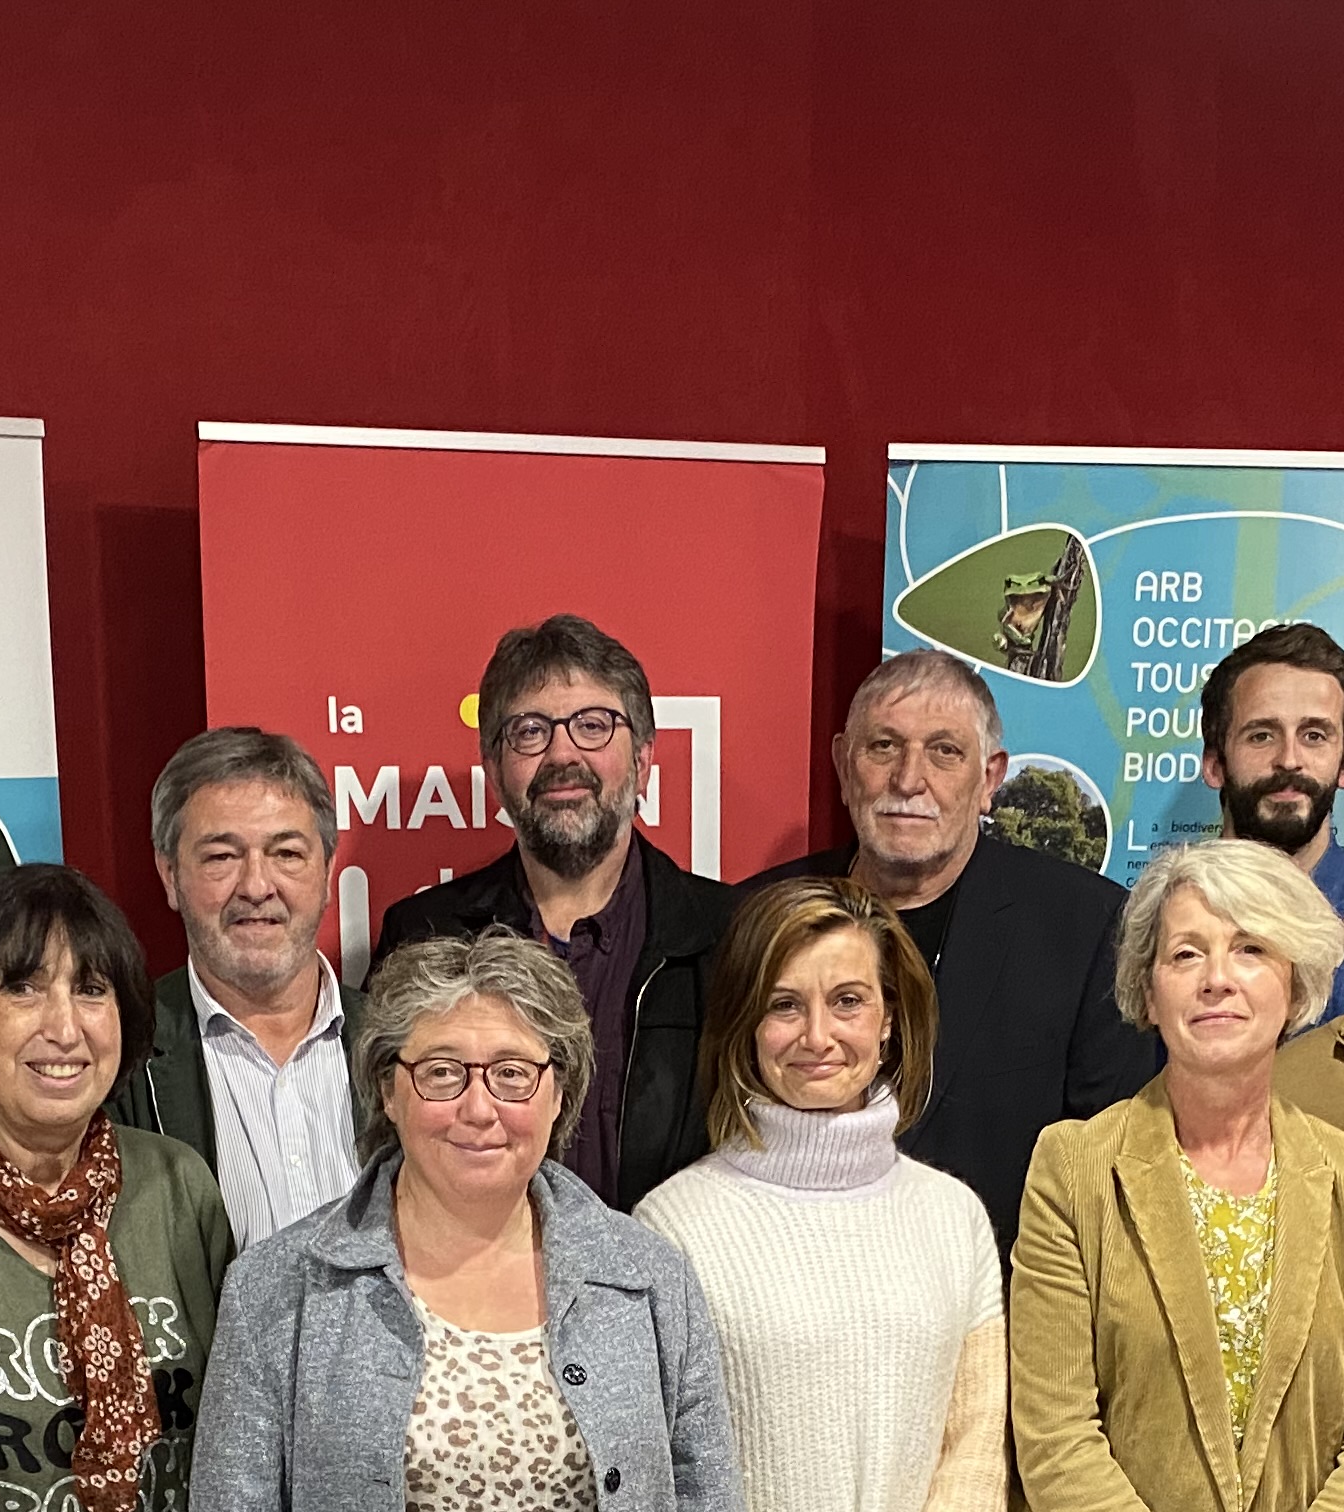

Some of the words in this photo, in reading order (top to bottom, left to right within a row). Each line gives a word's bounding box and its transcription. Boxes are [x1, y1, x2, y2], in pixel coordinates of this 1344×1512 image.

[1135, 570, 1203, 603] ARB
[1132, 616, 1313, 649] OCCITA
[327, 695, 364, 734] la
[334, 764, 661, 831] MAIN
[1171, 820, 1223, 833] biodiver
